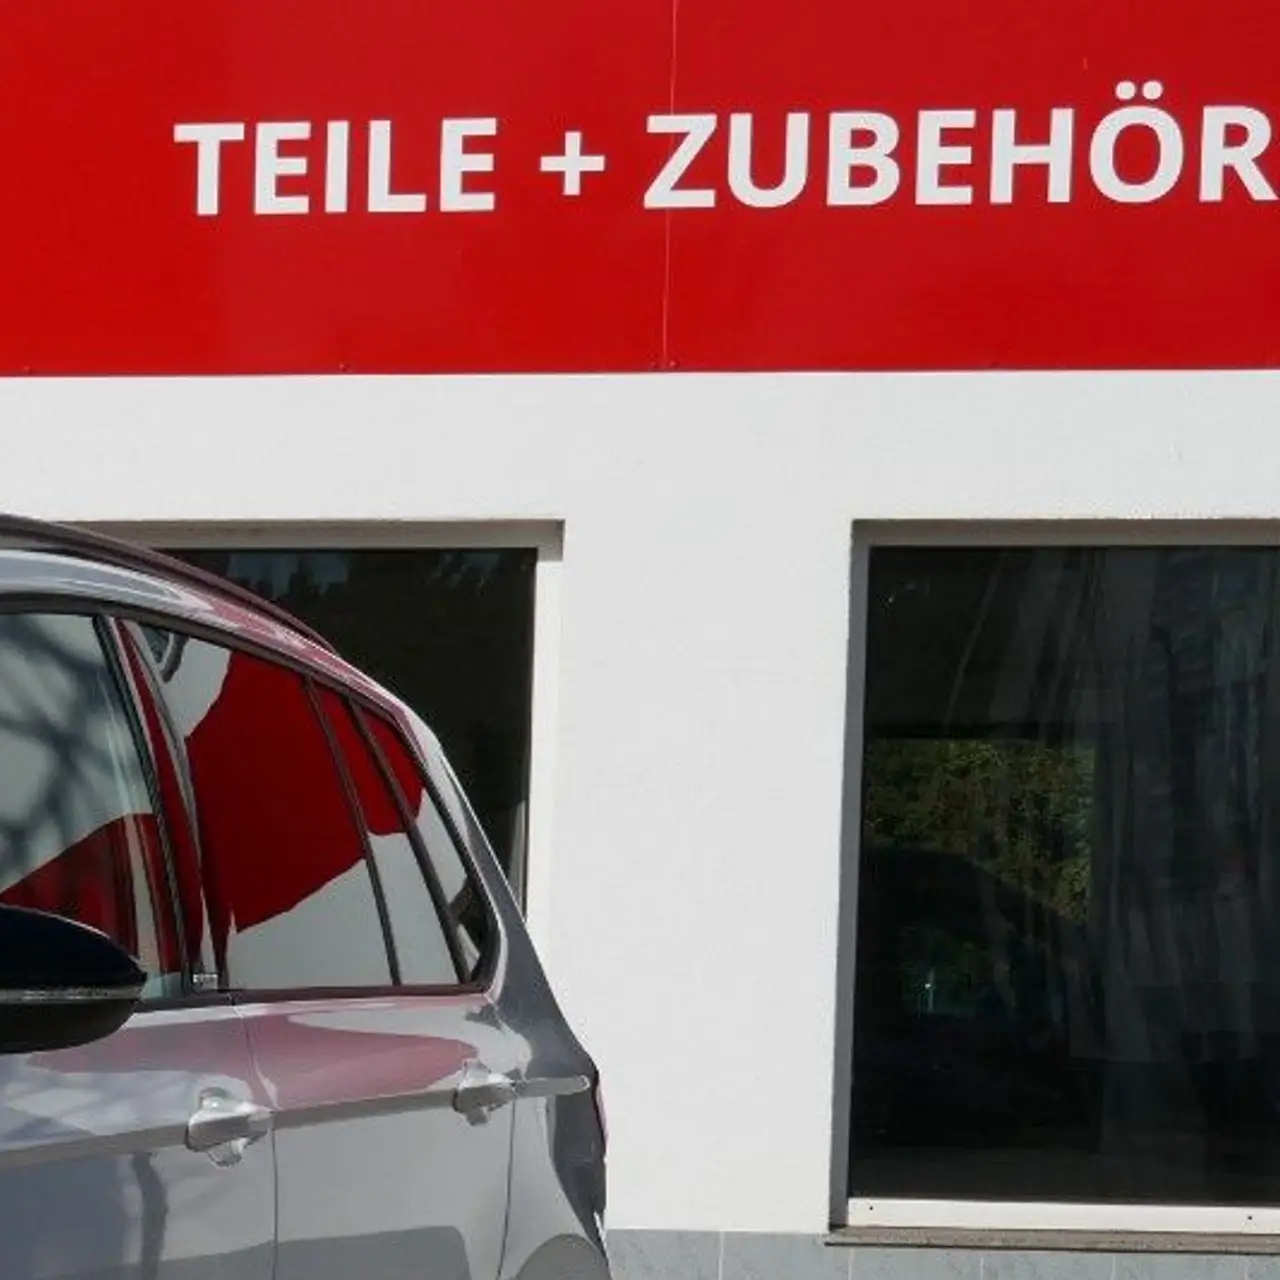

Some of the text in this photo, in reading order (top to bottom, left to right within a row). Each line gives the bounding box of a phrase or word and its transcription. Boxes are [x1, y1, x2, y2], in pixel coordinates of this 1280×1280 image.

[173, 80, 1279, 216] TEILE + ZUBEHÖR
